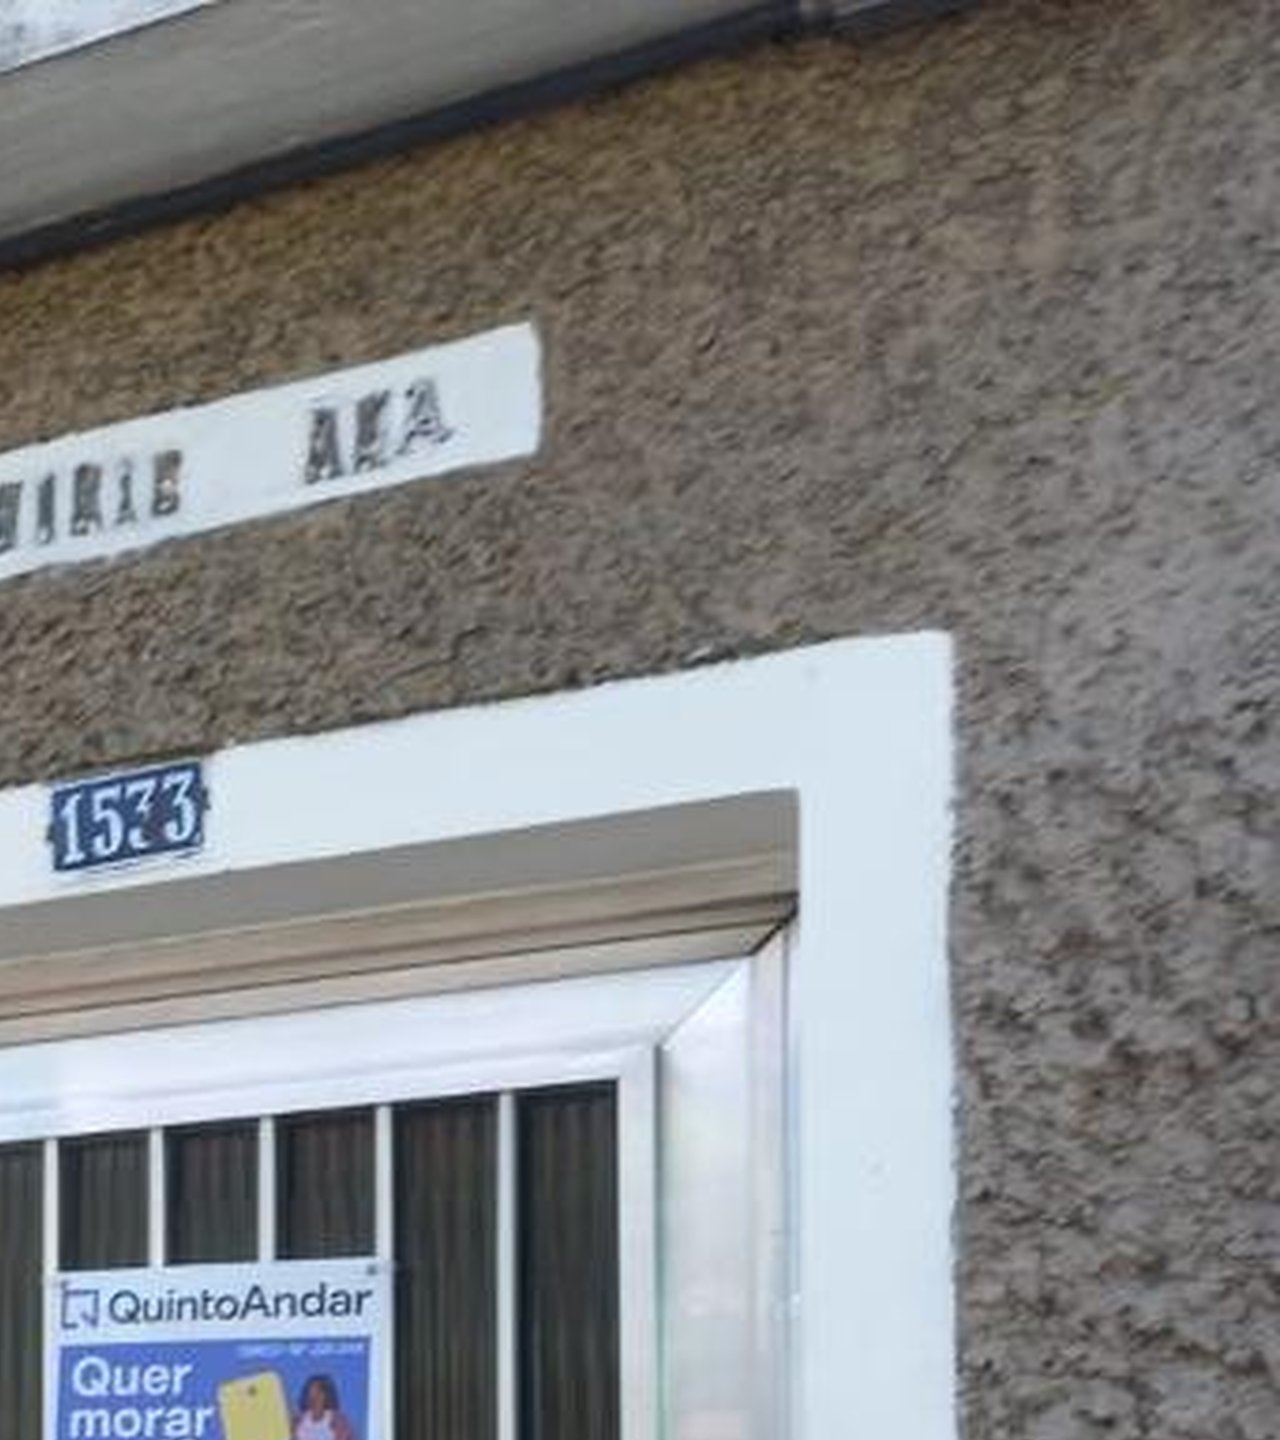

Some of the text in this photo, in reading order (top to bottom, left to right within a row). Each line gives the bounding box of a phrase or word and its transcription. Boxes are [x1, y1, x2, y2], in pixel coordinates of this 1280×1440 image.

[60, 770, 197, 865] 1533
[108, 1283, 373, 1325] QuintoAndar
[72, 1355, 193, 1397] Quer
[69, 1405, 215, 1438] morar
